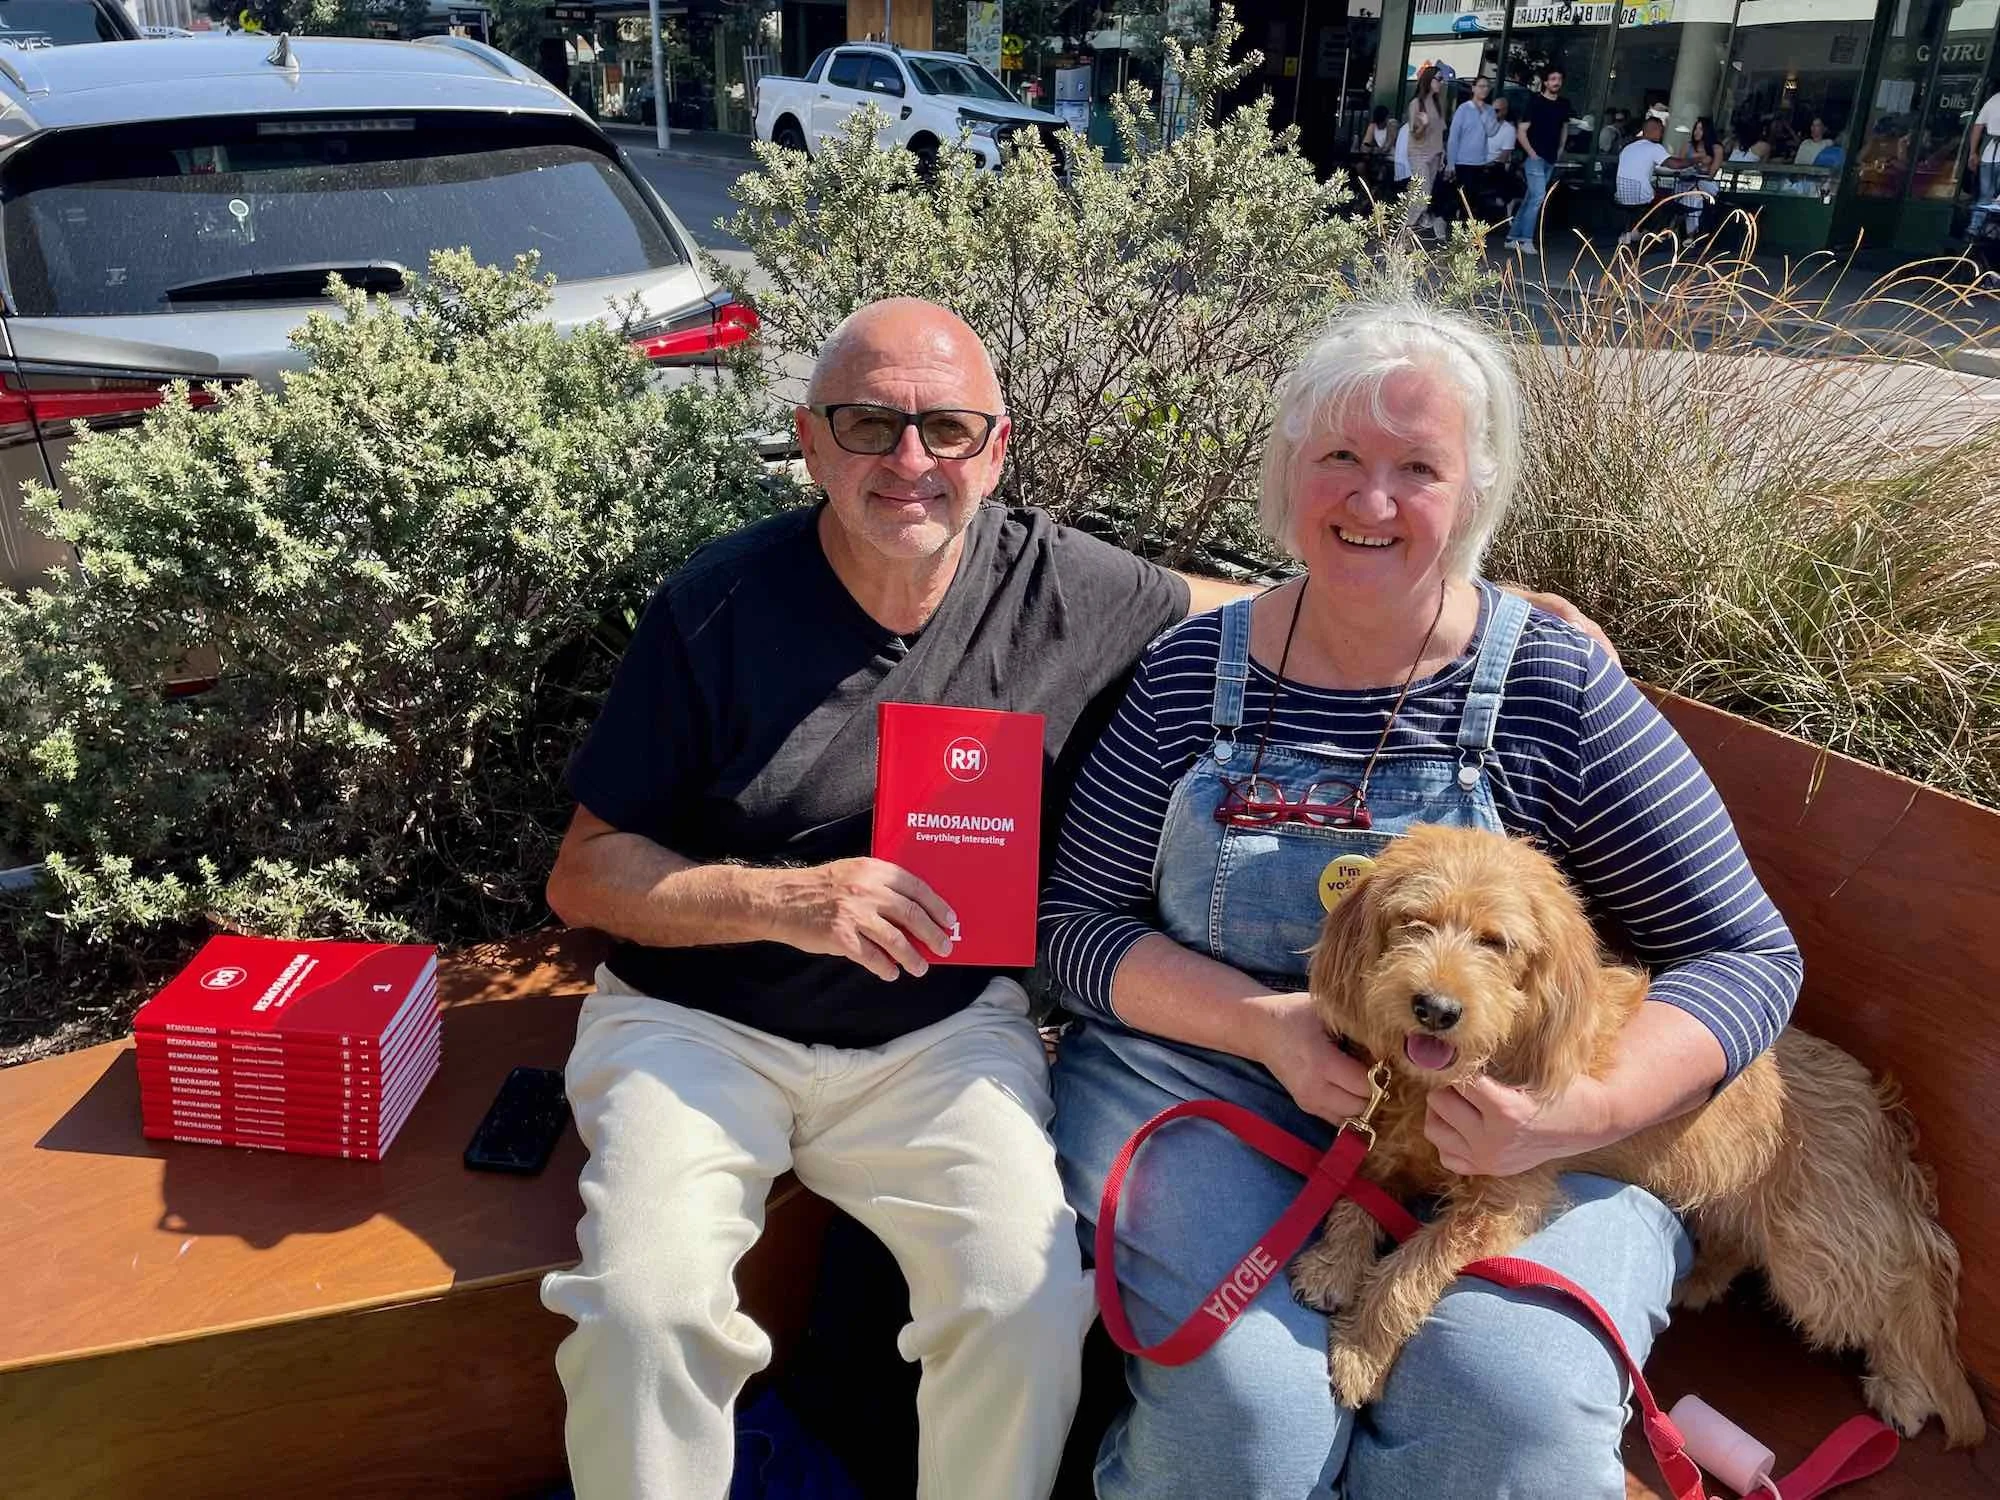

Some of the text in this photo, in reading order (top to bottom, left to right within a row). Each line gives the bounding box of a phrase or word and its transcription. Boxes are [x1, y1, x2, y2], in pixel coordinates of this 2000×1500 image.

[916, 831, 1005, 847] Everything Interesting
[1338, 866, 1361, 877] I'm
[373, 983, 392, 993] 1
